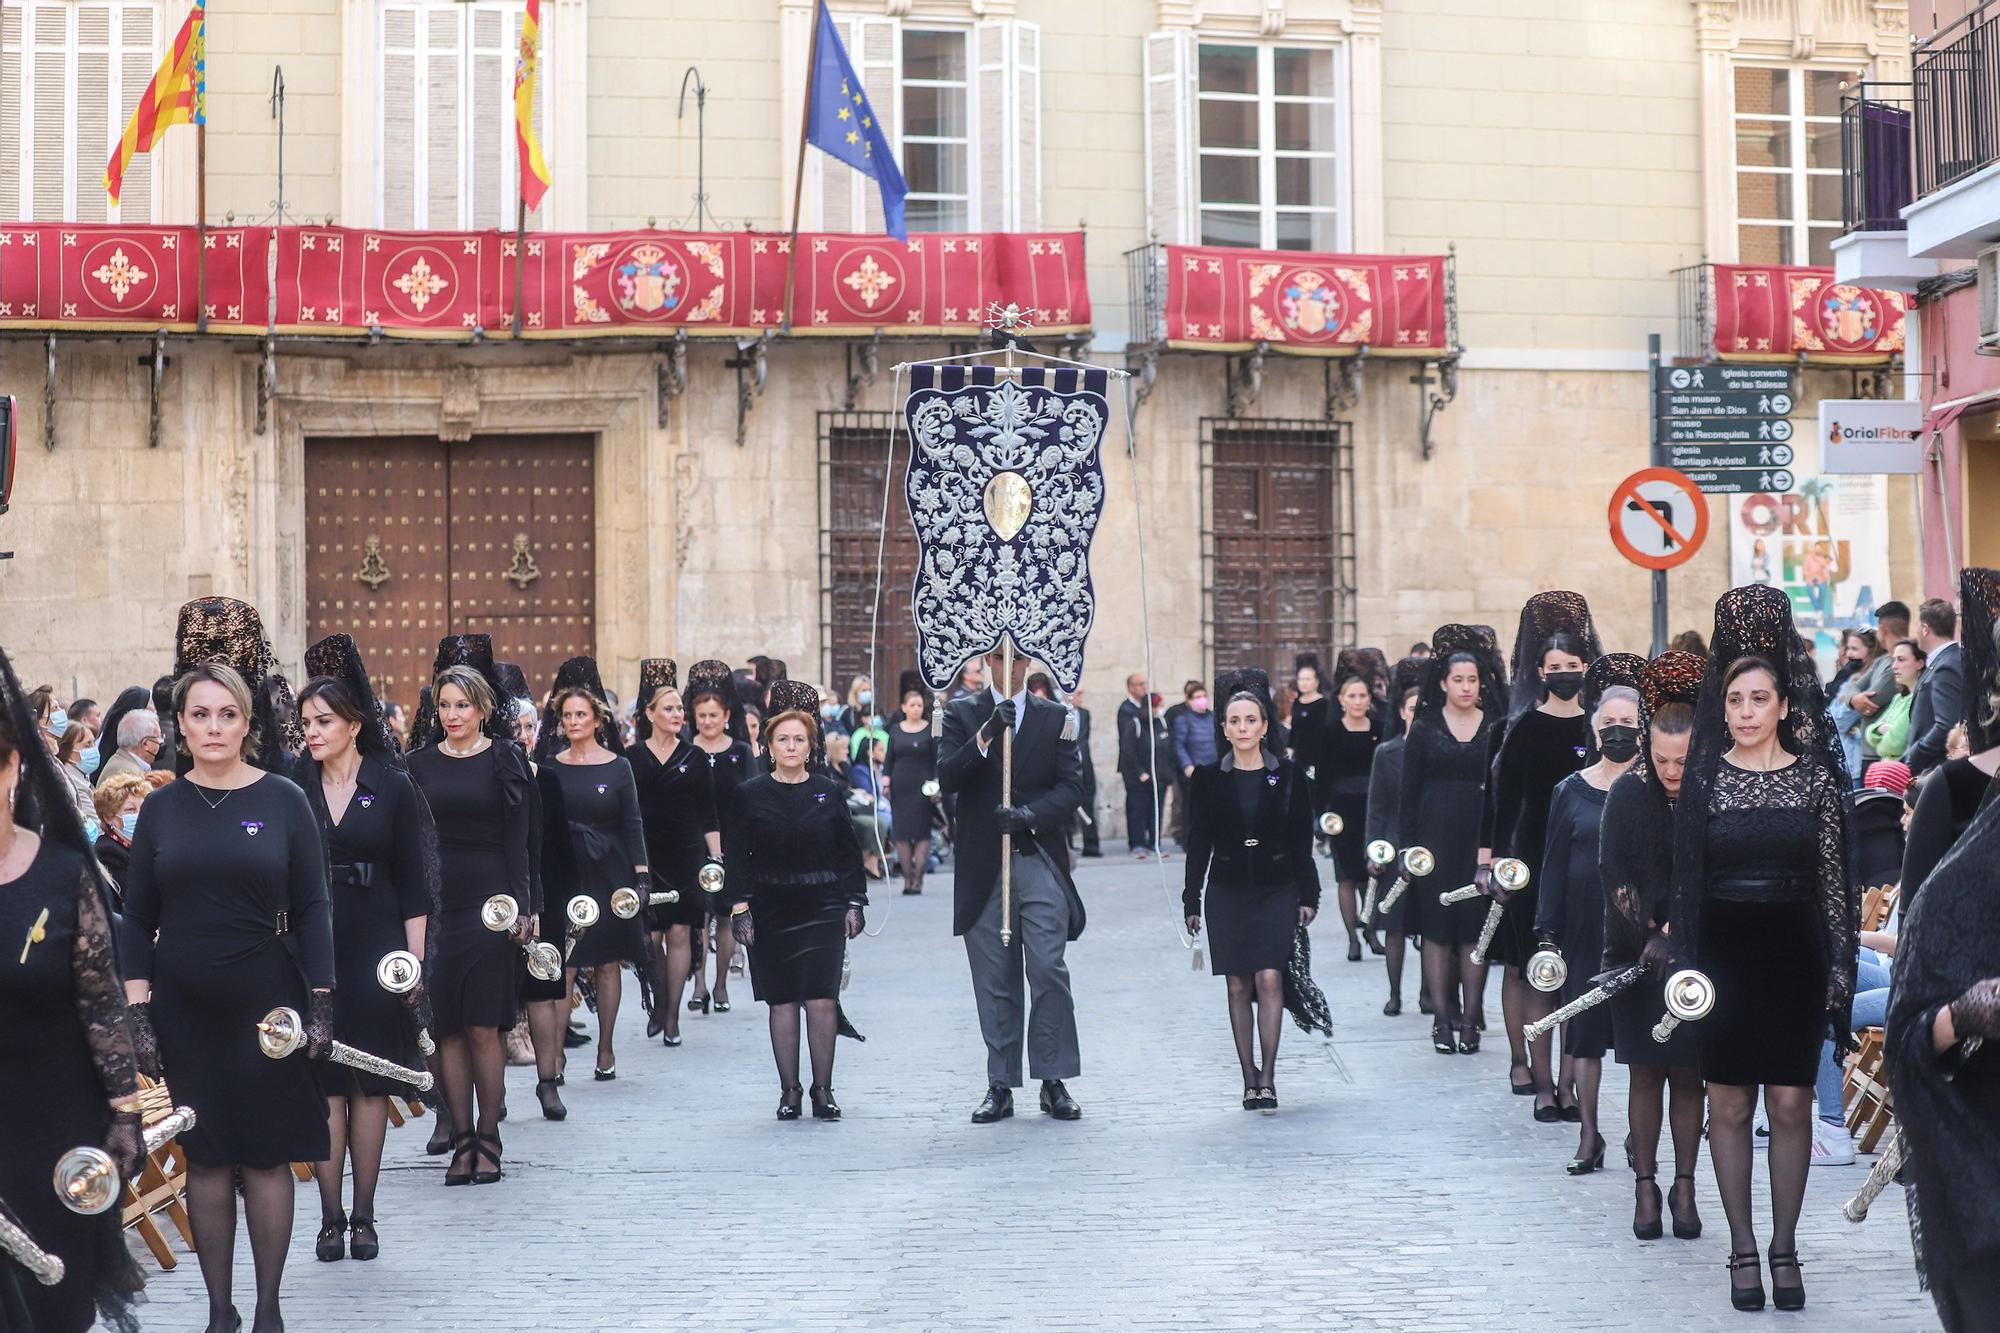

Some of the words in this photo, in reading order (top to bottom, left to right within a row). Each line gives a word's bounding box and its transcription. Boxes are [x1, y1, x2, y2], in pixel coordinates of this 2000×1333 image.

[1721, 369, 1748, 379] iglesia
[1750, 369, 1788, 377] convento
[1729, 381, 1740, 389] de
[1742, 381, 1753, 389] las
[1755, 381, 1788, 389] Salesas
[1672, 395, 1690, 403] sala
[1691, 406, 1712, 414] Juan
[1714, 406, 1725, 414] de
[1727, 406, 1747, 414] Dios
[1672, 431, 1684, 439] de
[1685, 431, 1694, 439] la
[1696, 431, 1750, 440] Reconquista
[1672, 447, 1701, 456] iglesia
[1673, 457, 1711, 467] Santiago
[1713, 457, 1747, 467] Apóstol
